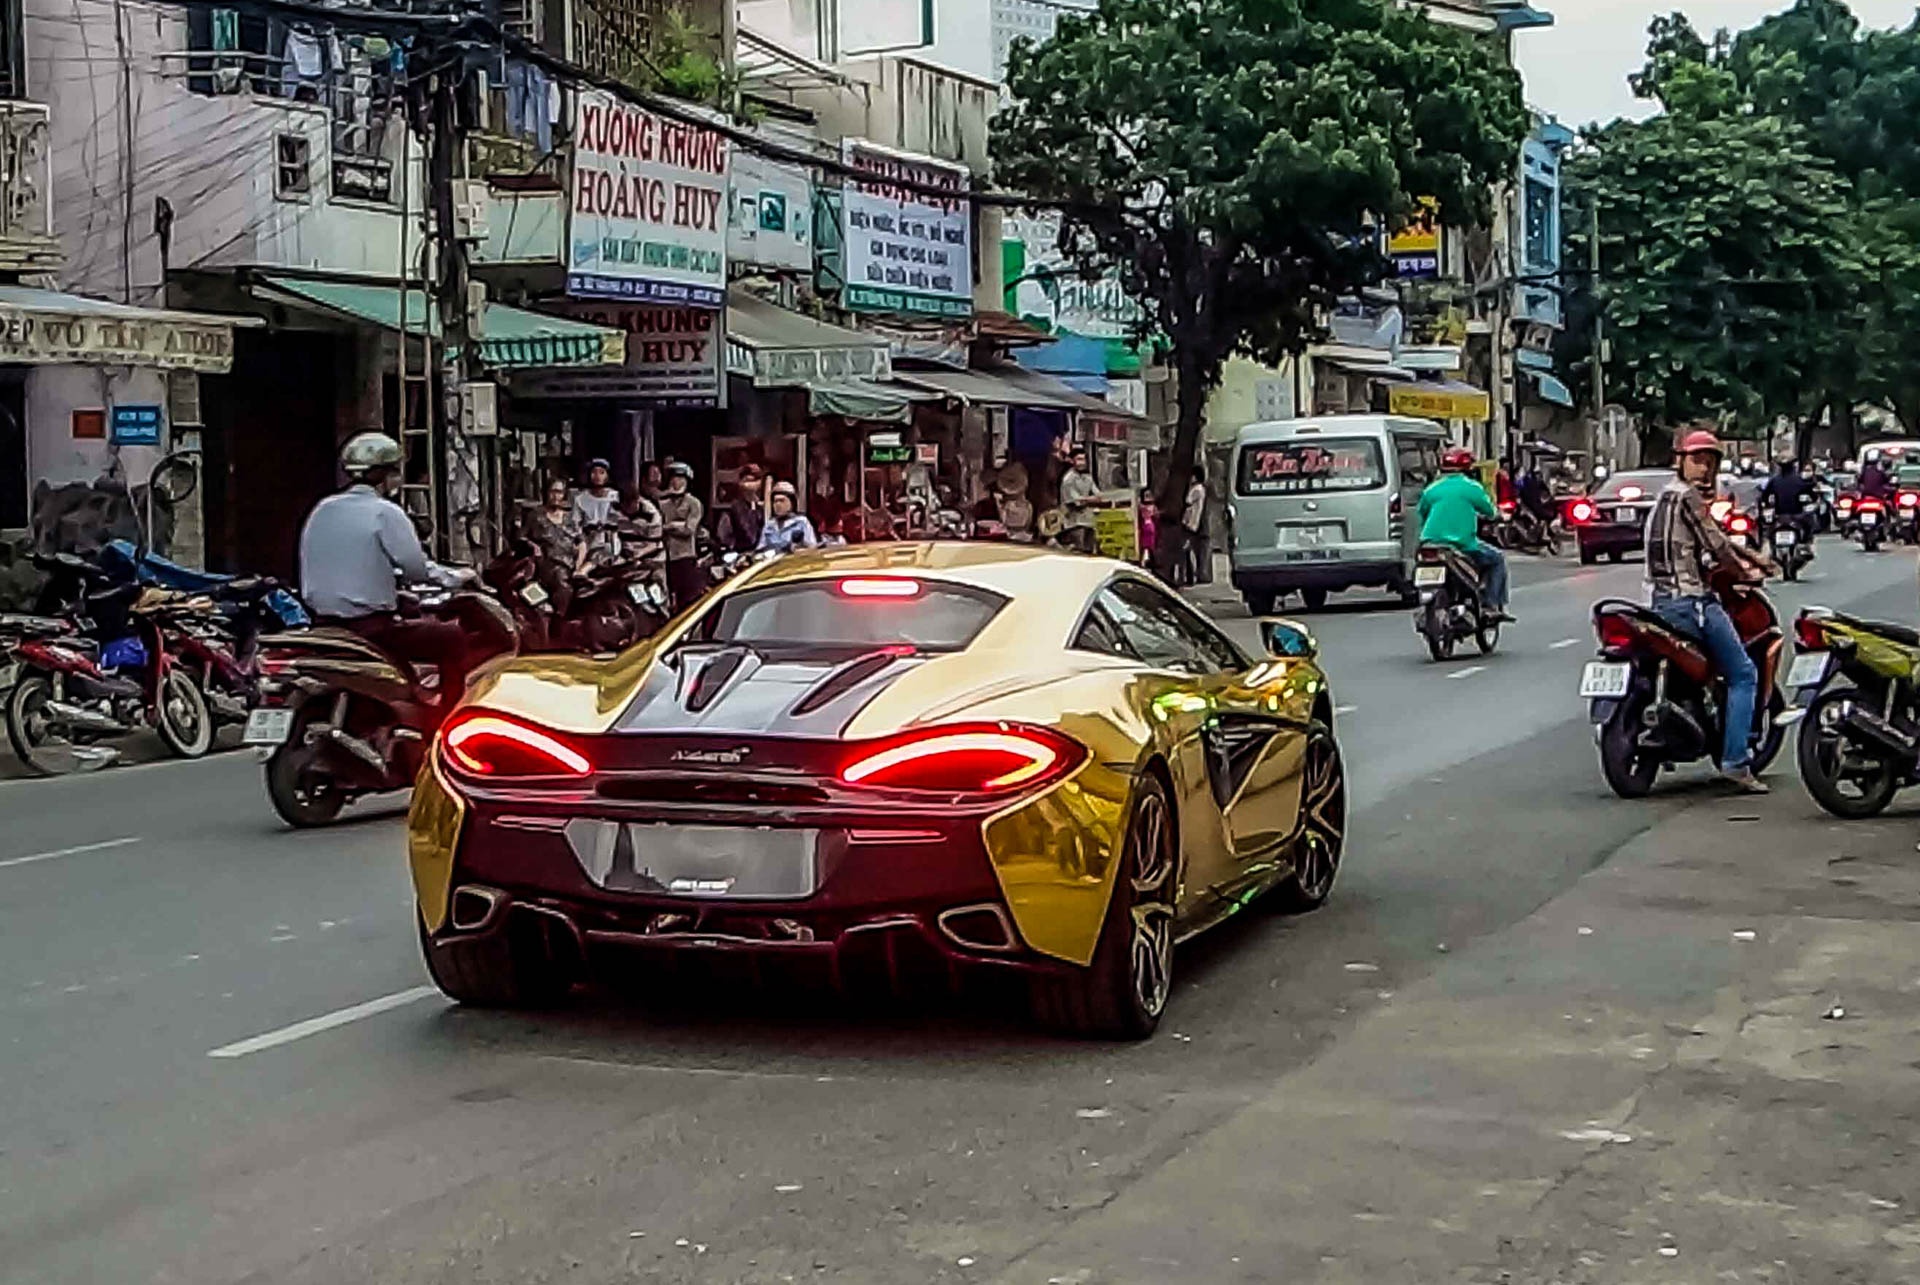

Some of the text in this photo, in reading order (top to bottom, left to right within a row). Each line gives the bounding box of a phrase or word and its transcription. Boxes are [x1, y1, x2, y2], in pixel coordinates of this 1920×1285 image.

[576, 161, 722, 233] HOÀNG HUY
[617, 309, 713, 333] KHUNG
[641, 339, 709, 363] HUY
